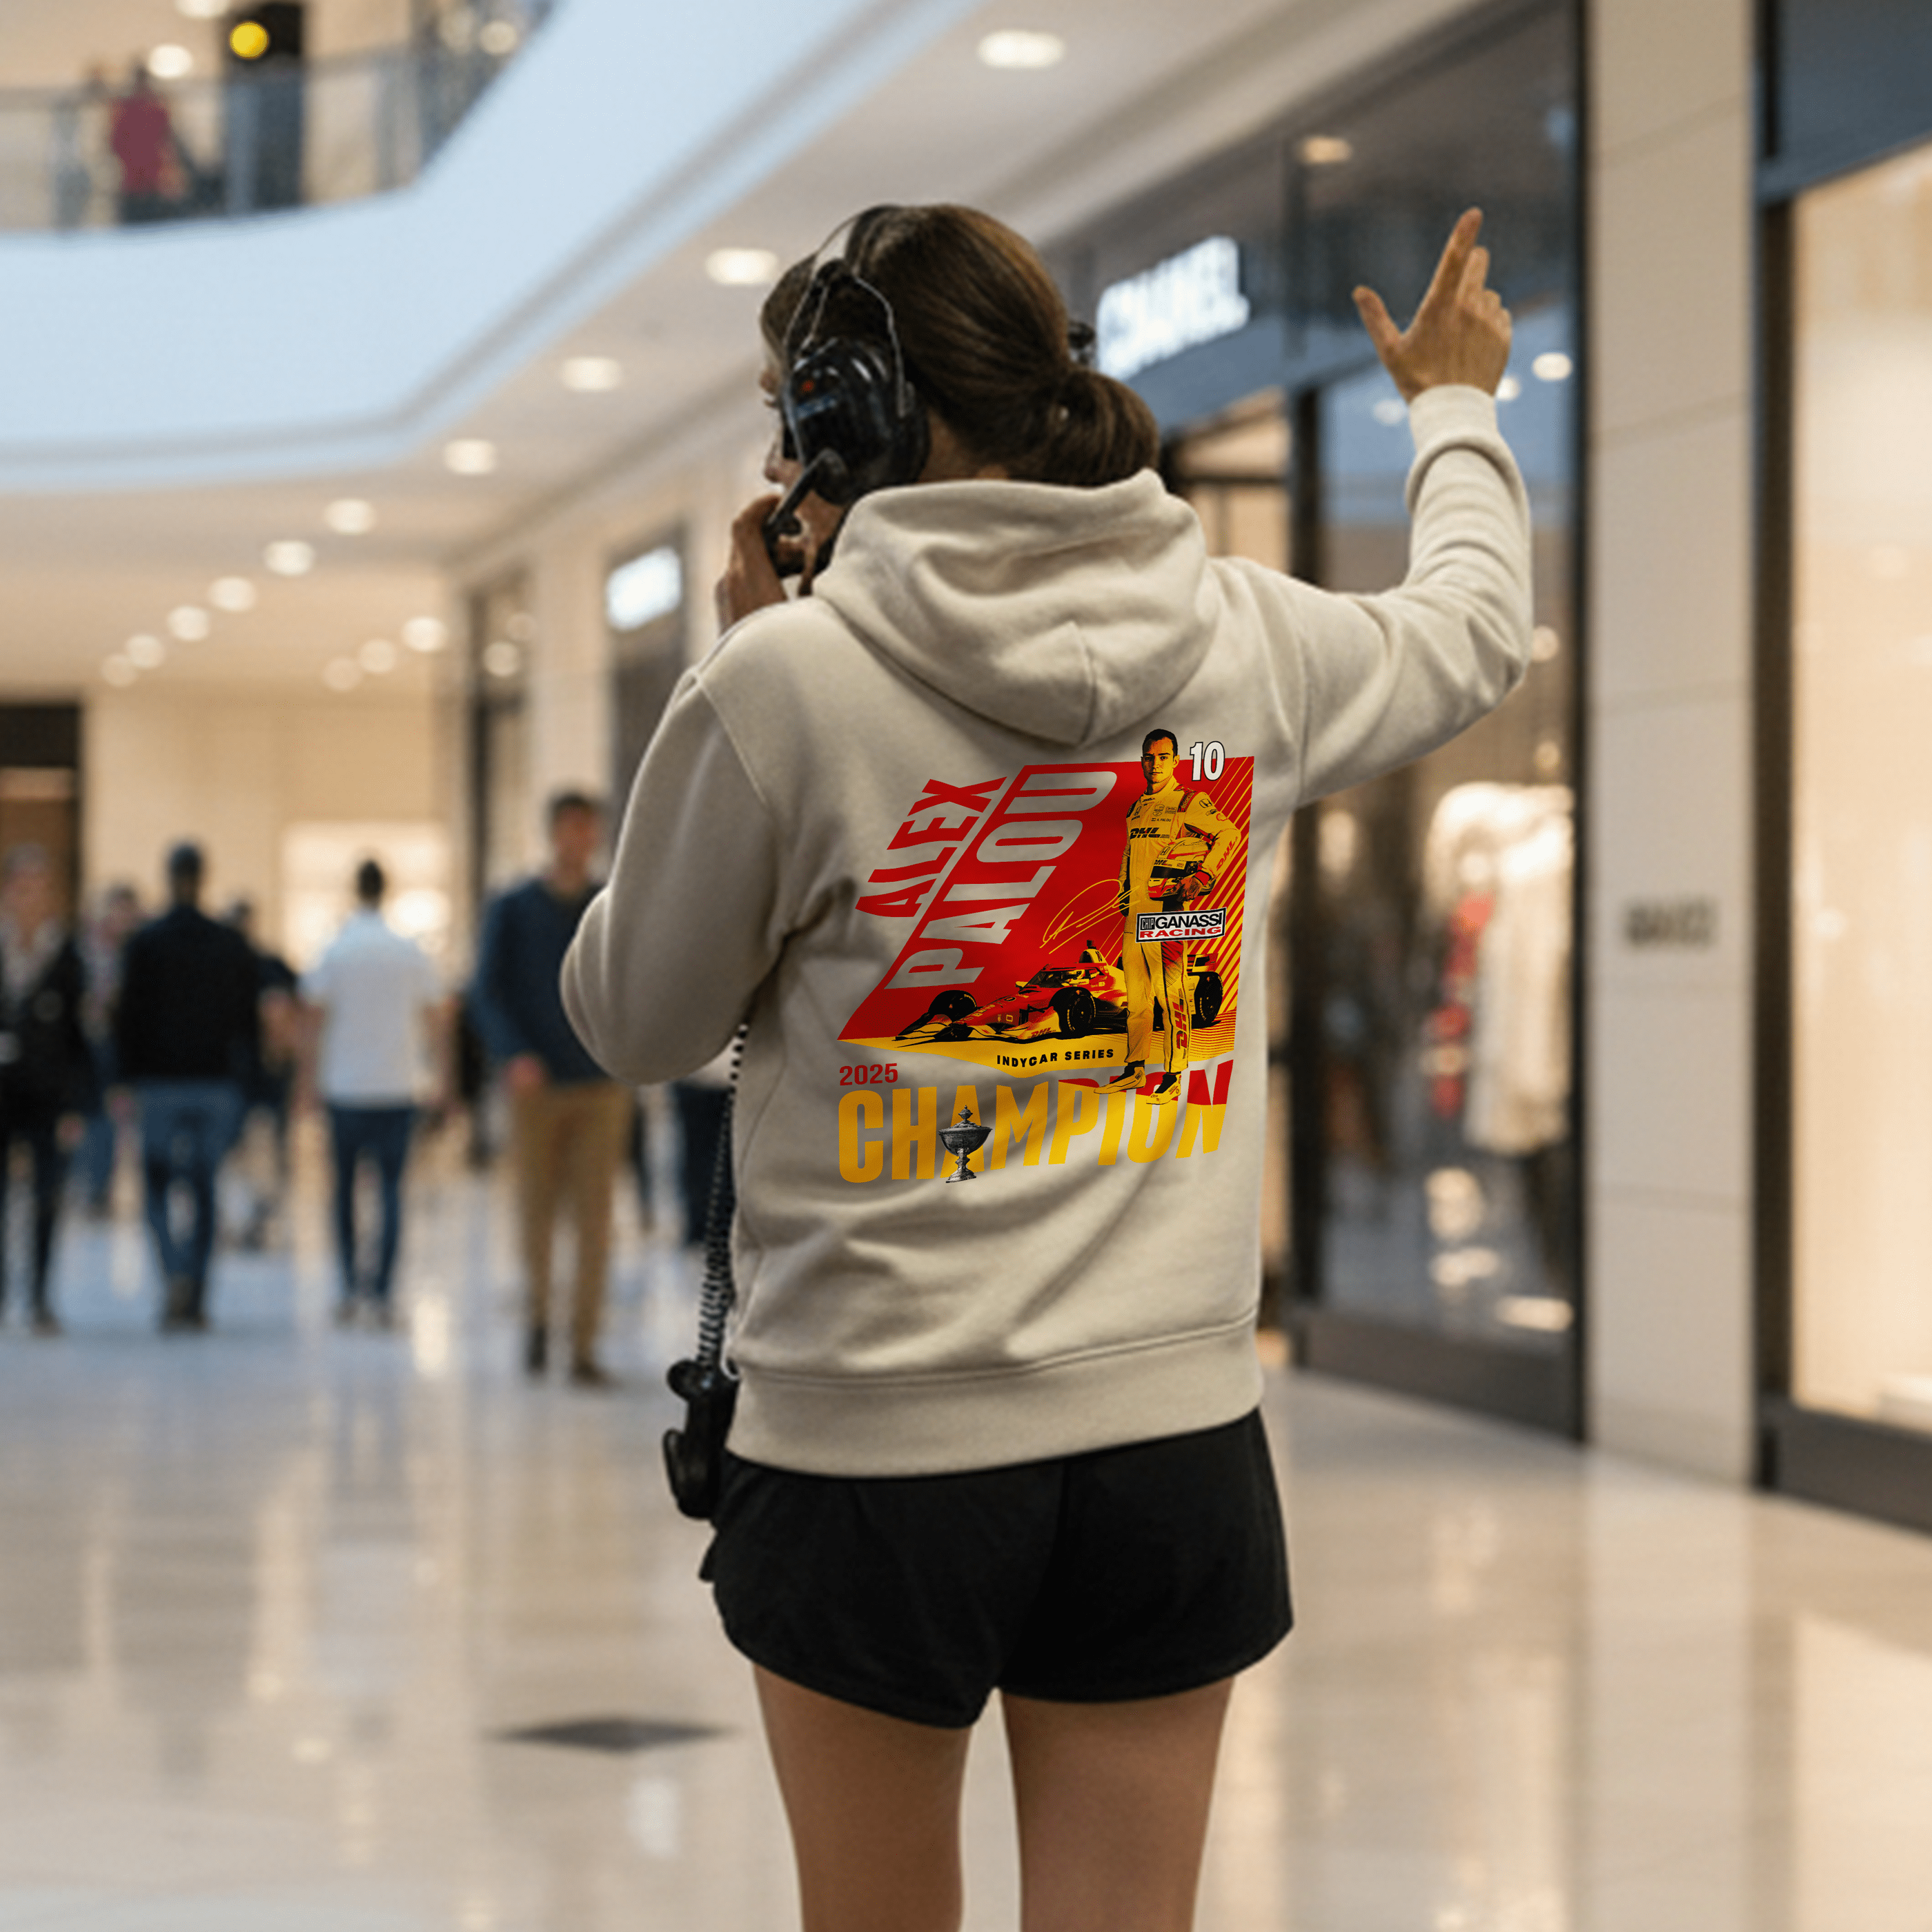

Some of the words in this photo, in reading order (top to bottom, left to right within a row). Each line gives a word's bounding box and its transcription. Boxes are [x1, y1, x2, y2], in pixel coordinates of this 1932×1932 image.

[1190, 740, 1225, 782] 10
[855, 776, 1007, 918] ALEX
[1130, 827, 1161, 840] DHL
[1216, 840, 1236, 871] DHL
[883, 771, 1118, 989] PALOU
[1140, 927, 1221, 938] RACING
[1141, 918, 1155, 930] CHIP
[1155, 912, 1223, 929] GANASSI
[1172, 998, 1187, 1049] DHL
[997, 1052, 1058, 1067] INDYCAR
[1065, 1049, 1114, 1061] SERIES
[840, 1063, 898, 1086] 2025
[838, 1059, 1234, 1183] CHAMPION
